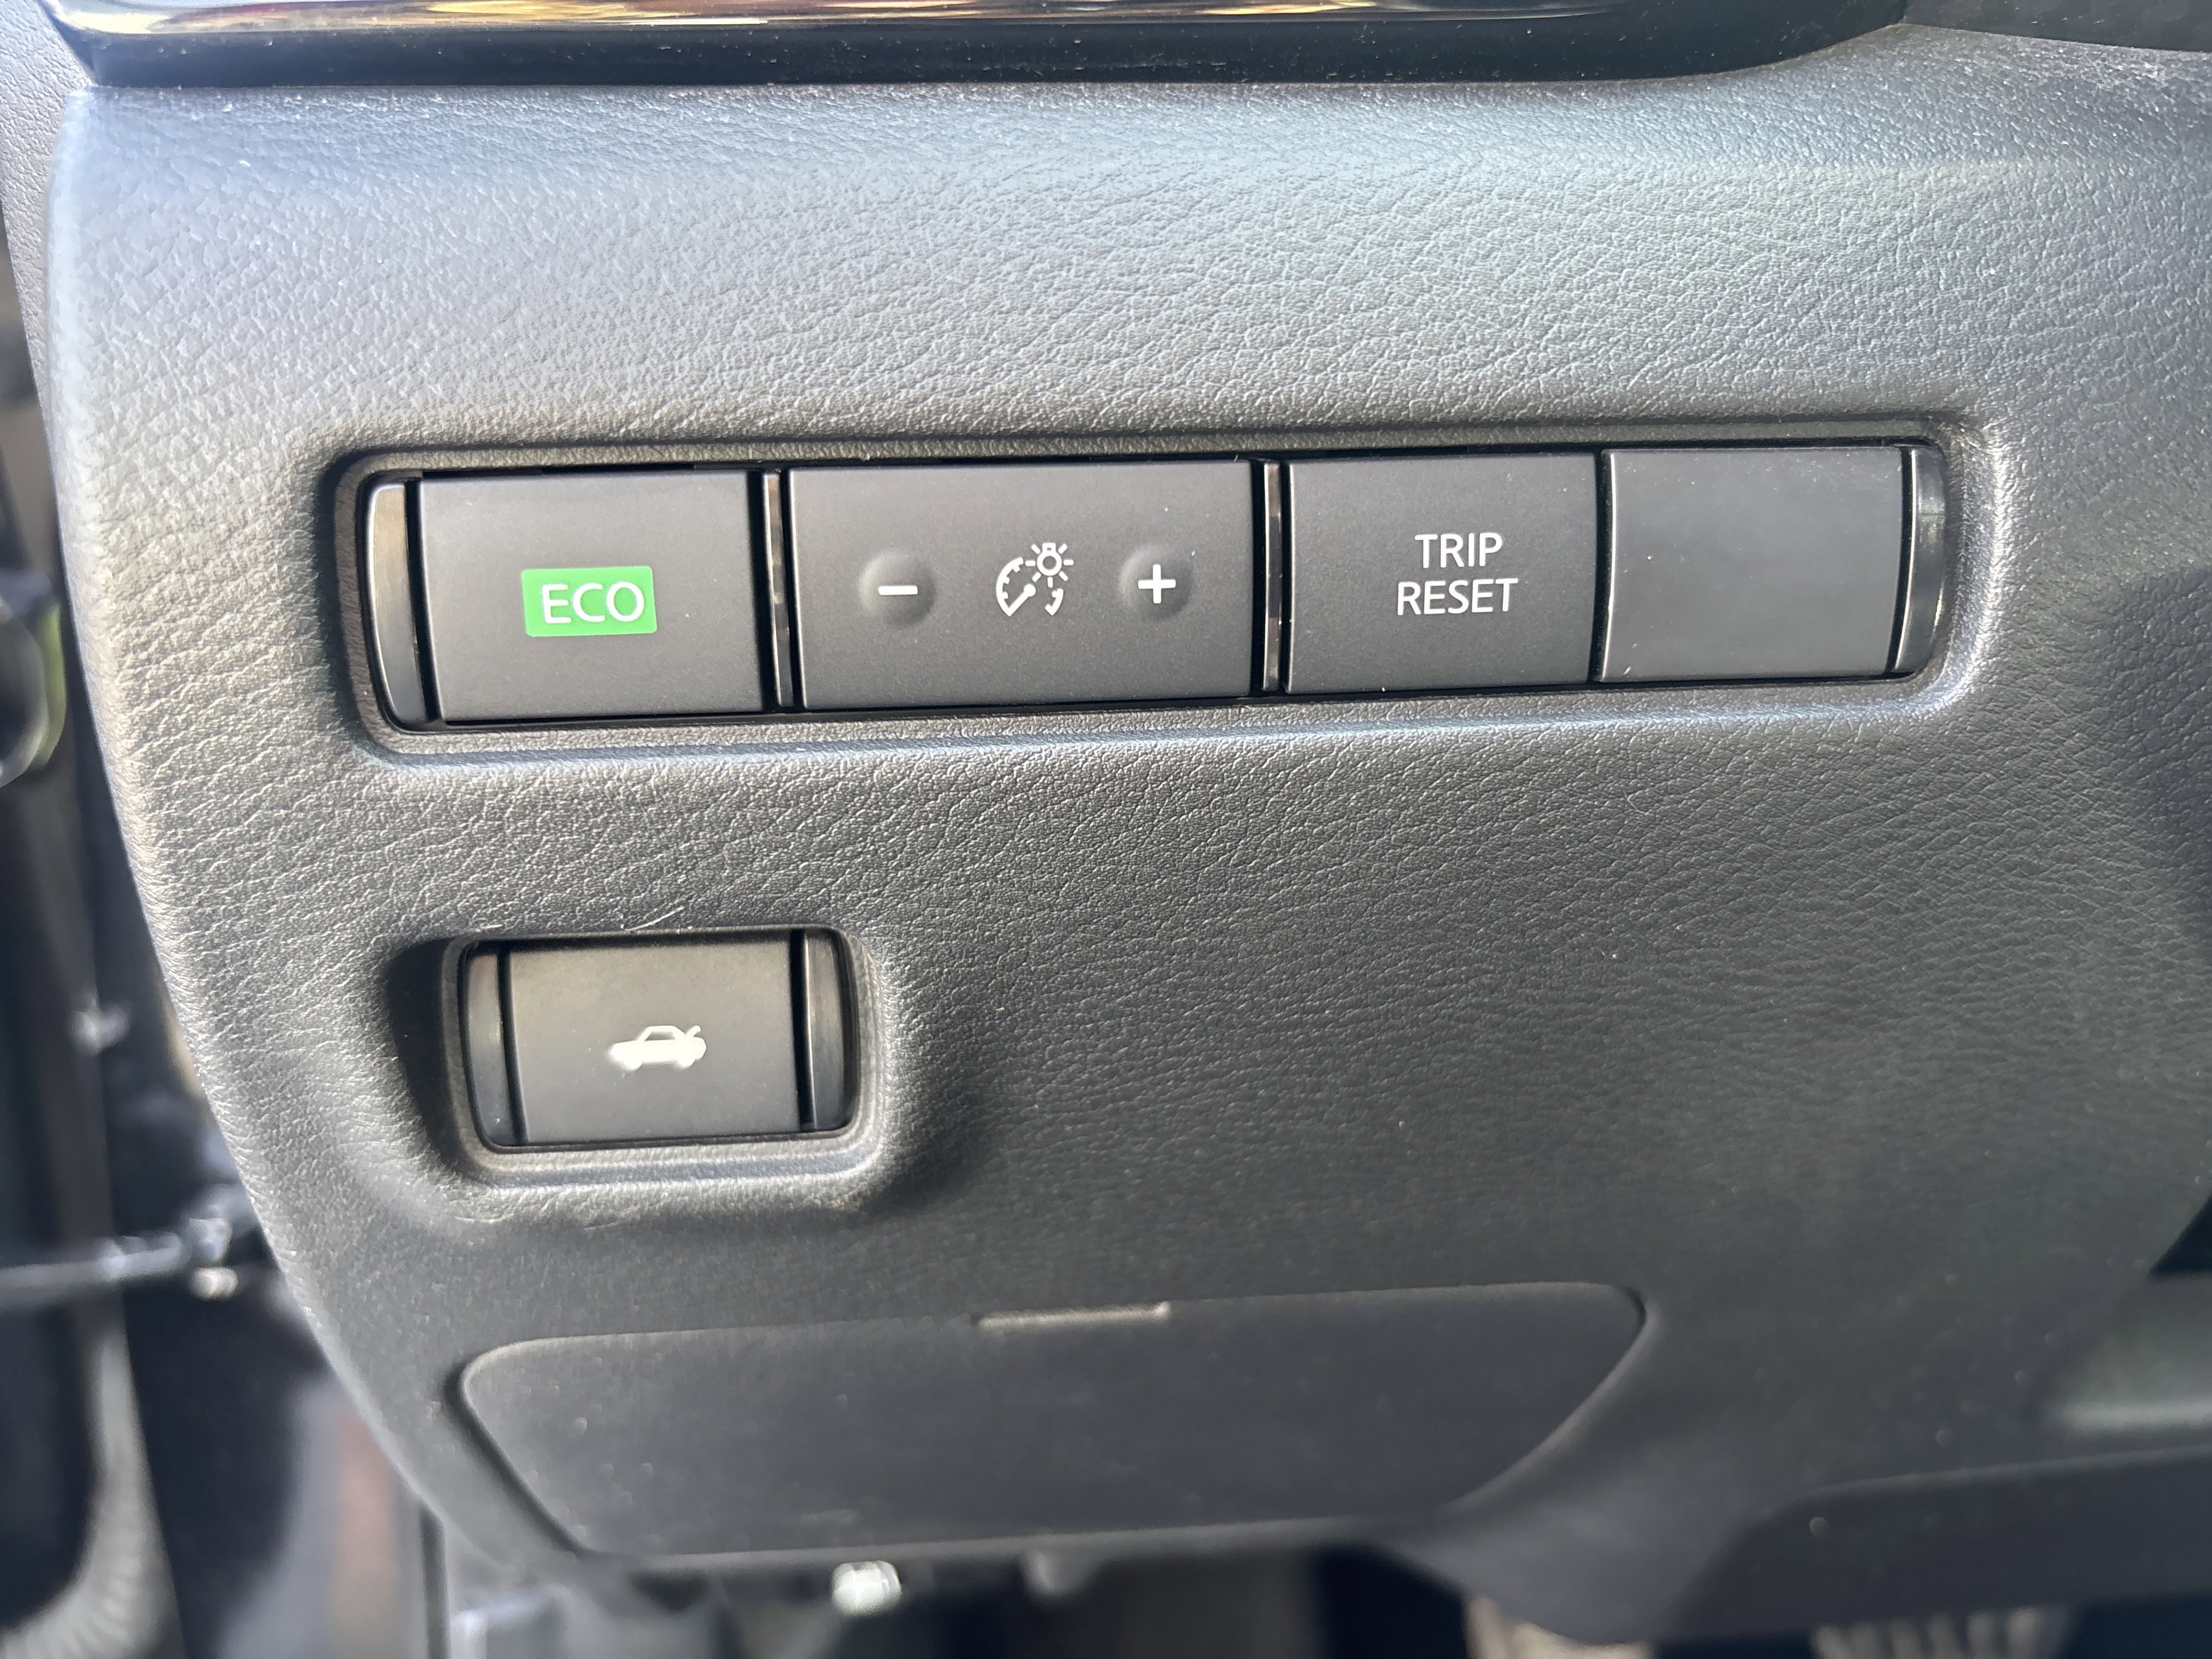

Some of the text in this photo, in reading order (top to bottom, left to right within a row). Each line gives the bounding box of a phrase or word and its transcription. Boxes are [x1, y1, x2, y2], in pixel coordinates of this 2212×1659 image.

[1414, 532, 1503, 569] TRIP
[541, 580, 645, 624] ECO
[1397, 577, 1520, 616] RESET
